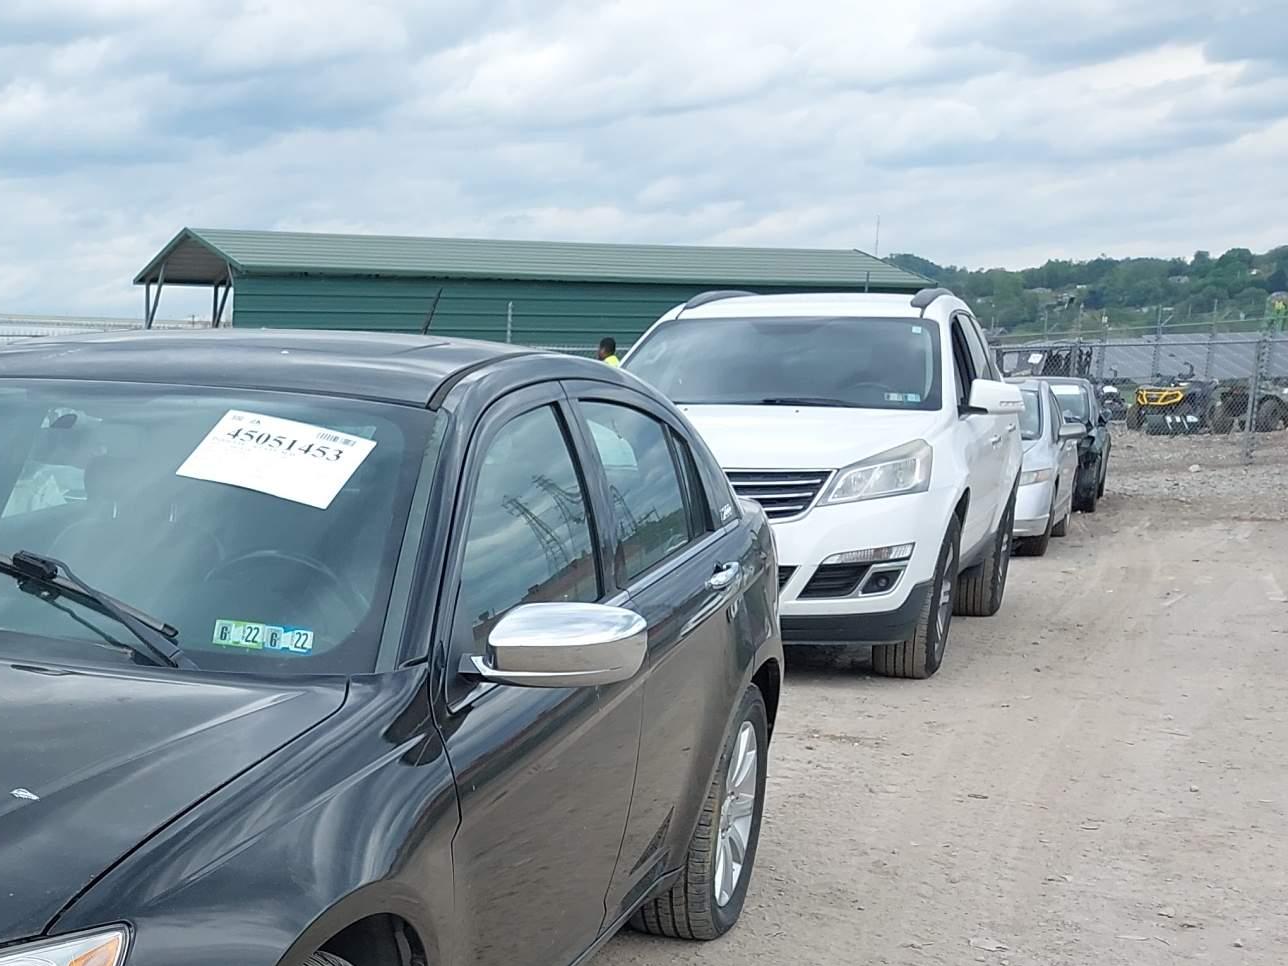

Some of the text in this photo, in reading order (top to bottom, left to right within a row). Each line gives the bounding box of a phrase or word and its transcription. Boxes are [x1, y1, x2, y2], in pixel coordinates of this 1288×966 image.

[226, 428, 343, 461] 45051453
[220, 626, 260, 643] 6 22
[270, 632, 309, 649] 6 22
